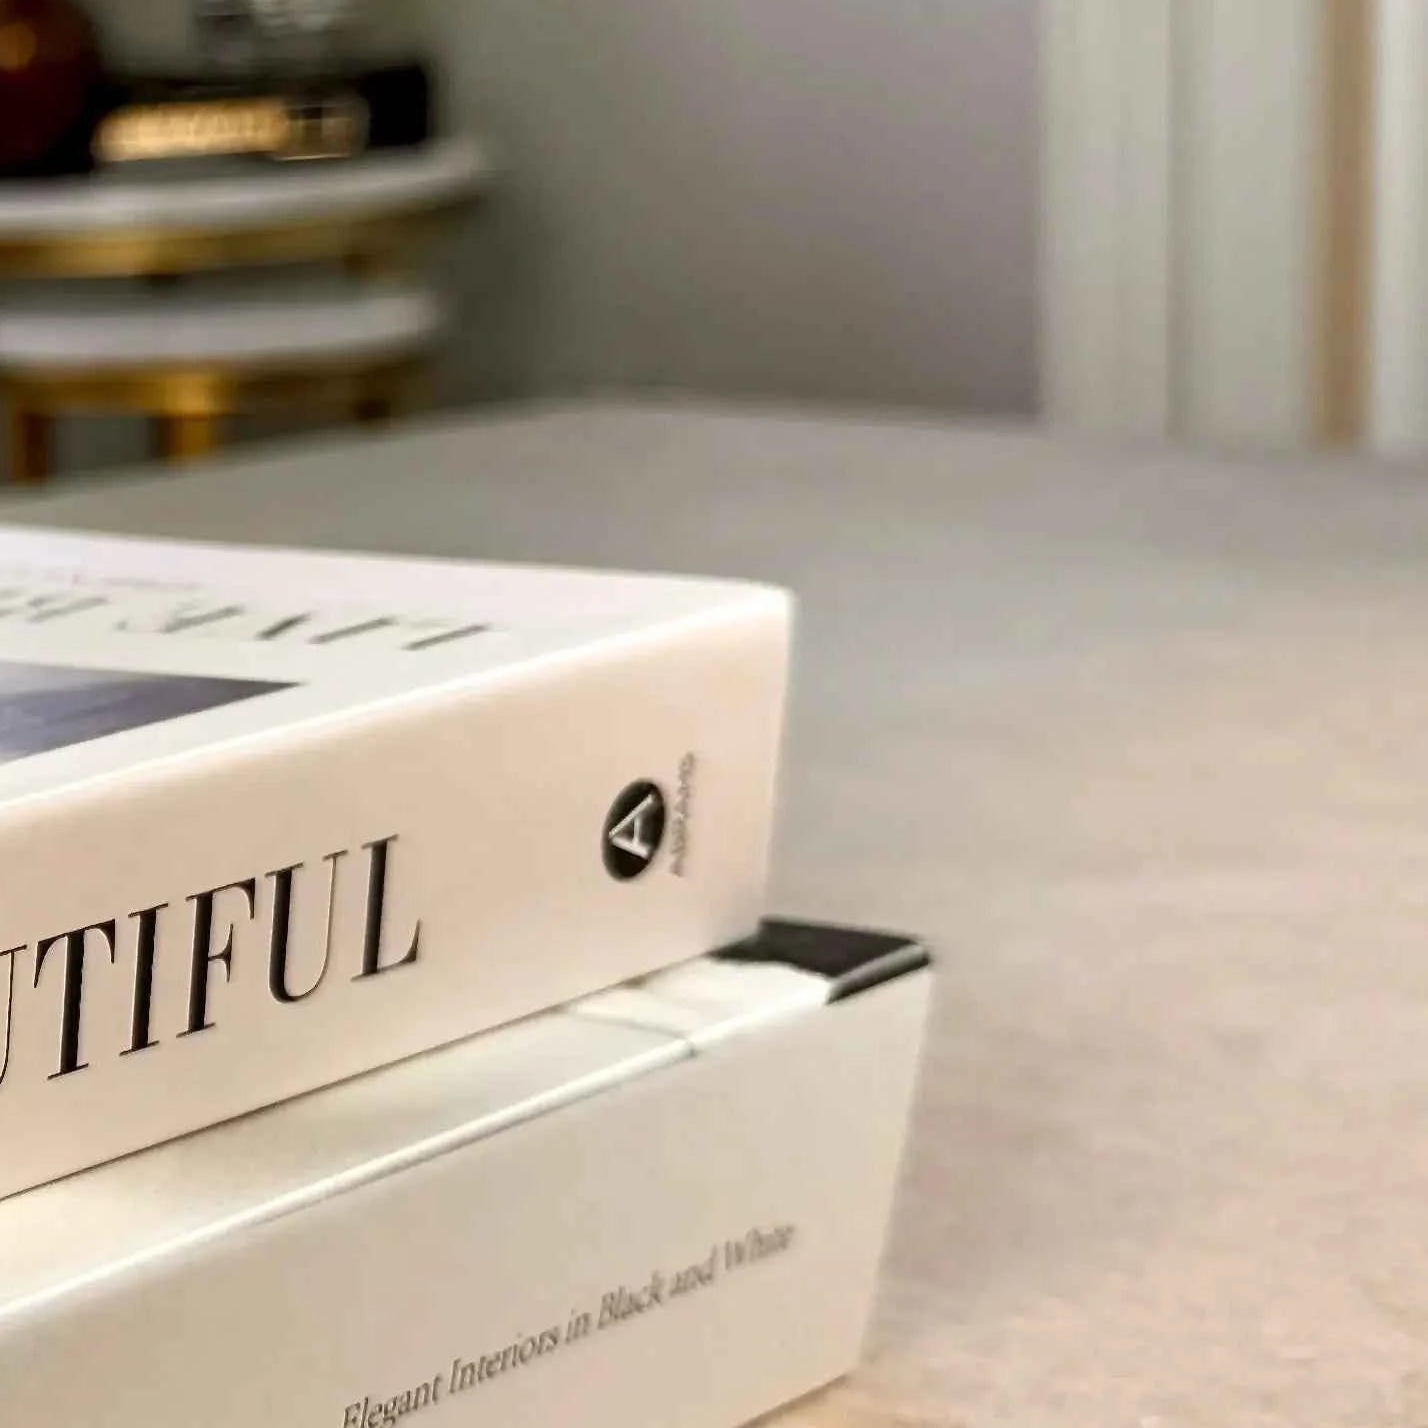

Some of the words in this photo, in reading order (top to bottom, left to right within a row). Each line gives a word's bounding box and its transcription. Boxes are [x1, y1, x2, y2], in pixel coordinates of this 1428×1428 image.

[448, 1333, 560, 1395] Interiors
[564, 1308, 593, 1344] in
[596, 1270, 667, 1331] Black
[669, 1243, 720, 1299] and
[722, 1222, 798, 1272] White
